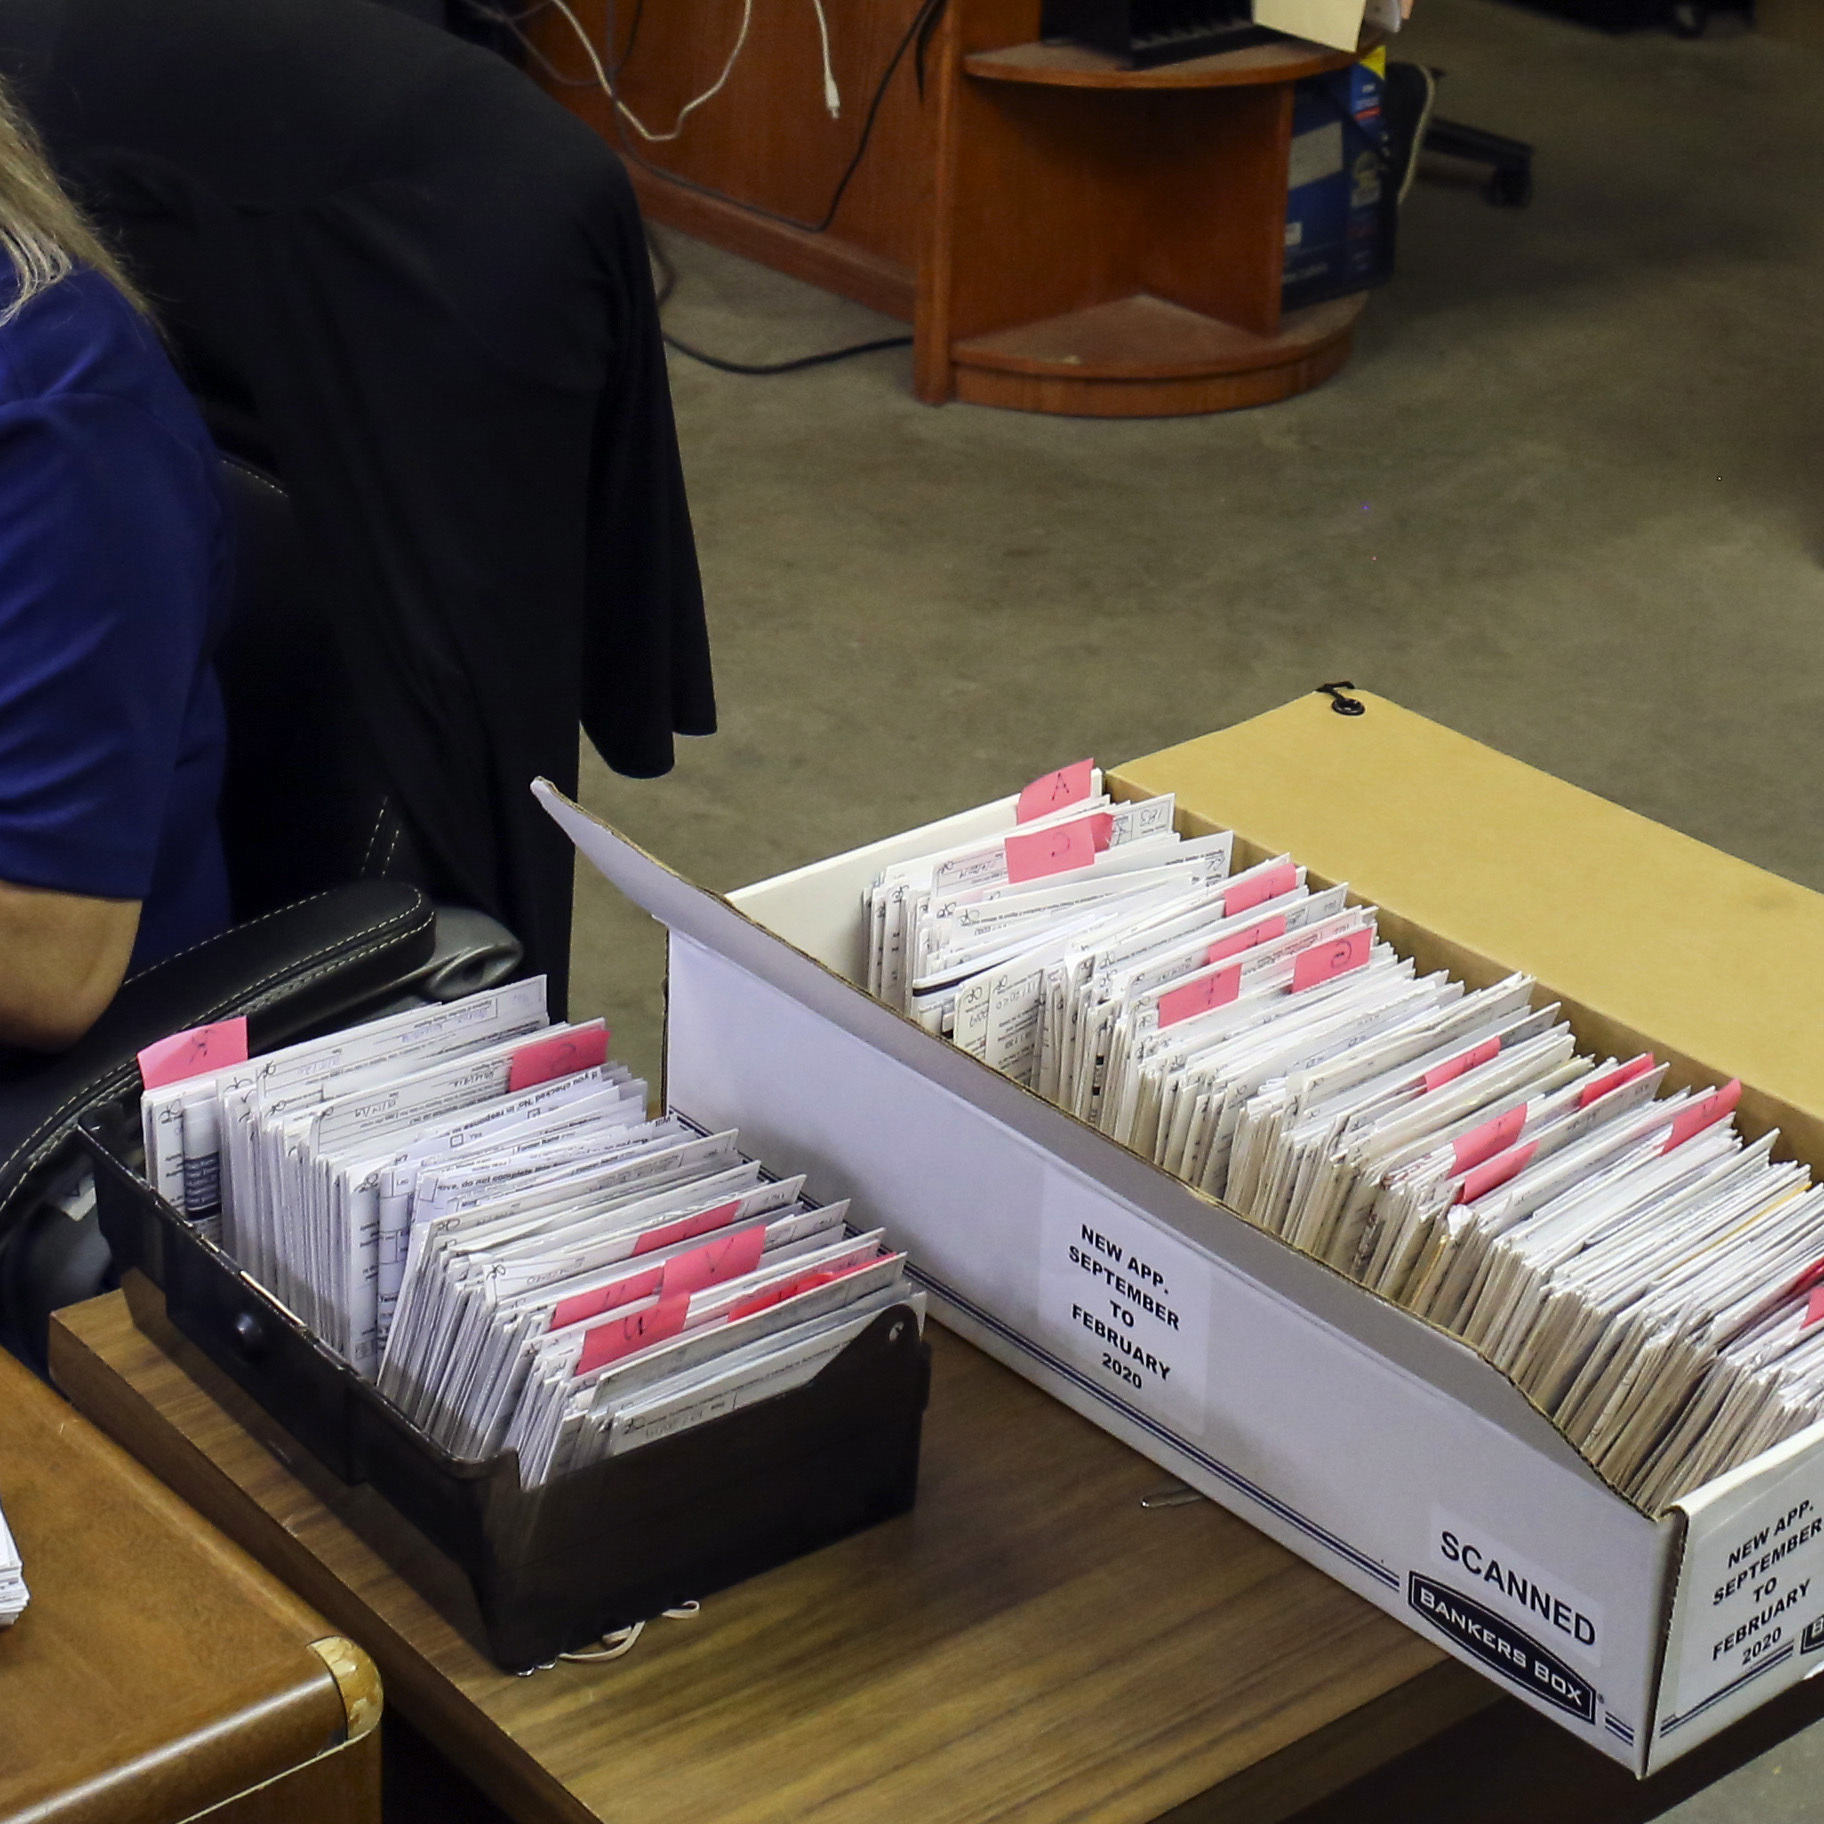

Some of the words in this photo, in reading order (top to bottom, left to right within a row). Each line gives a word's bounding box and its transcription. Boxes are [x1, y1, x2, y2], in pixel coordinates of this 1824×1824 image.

[1068, 1245, 1180, 1331] SEPTEMBER
[1081, 1223, 1123, 1263] NEW
[1127, 1256, 1169, 1295] APP.
[1072, 1303, 1172, 1381] FEBRUARY
[1109, 1299, 1135, 1328] TO
[1102, 1352, 1143, 1390] 2020
[1713, 1517, 1823, 1606] SEPTEMBER
[1728, 1527, 1770, 1569] NEW
[1774, 1499, 1814, 1537] APP.
[1440, 1530, 1596, 1646] SCANNED
[1713, 1578, 1811, 1661] FEBRUARY
[1753, 1576, 1777, 1603] TO
[1420, 1586, 1527, 1668] BANKERS
[1534, 1659, 1582, 1706] BOX
[1742, 1626, 1782, 1665] 2020
